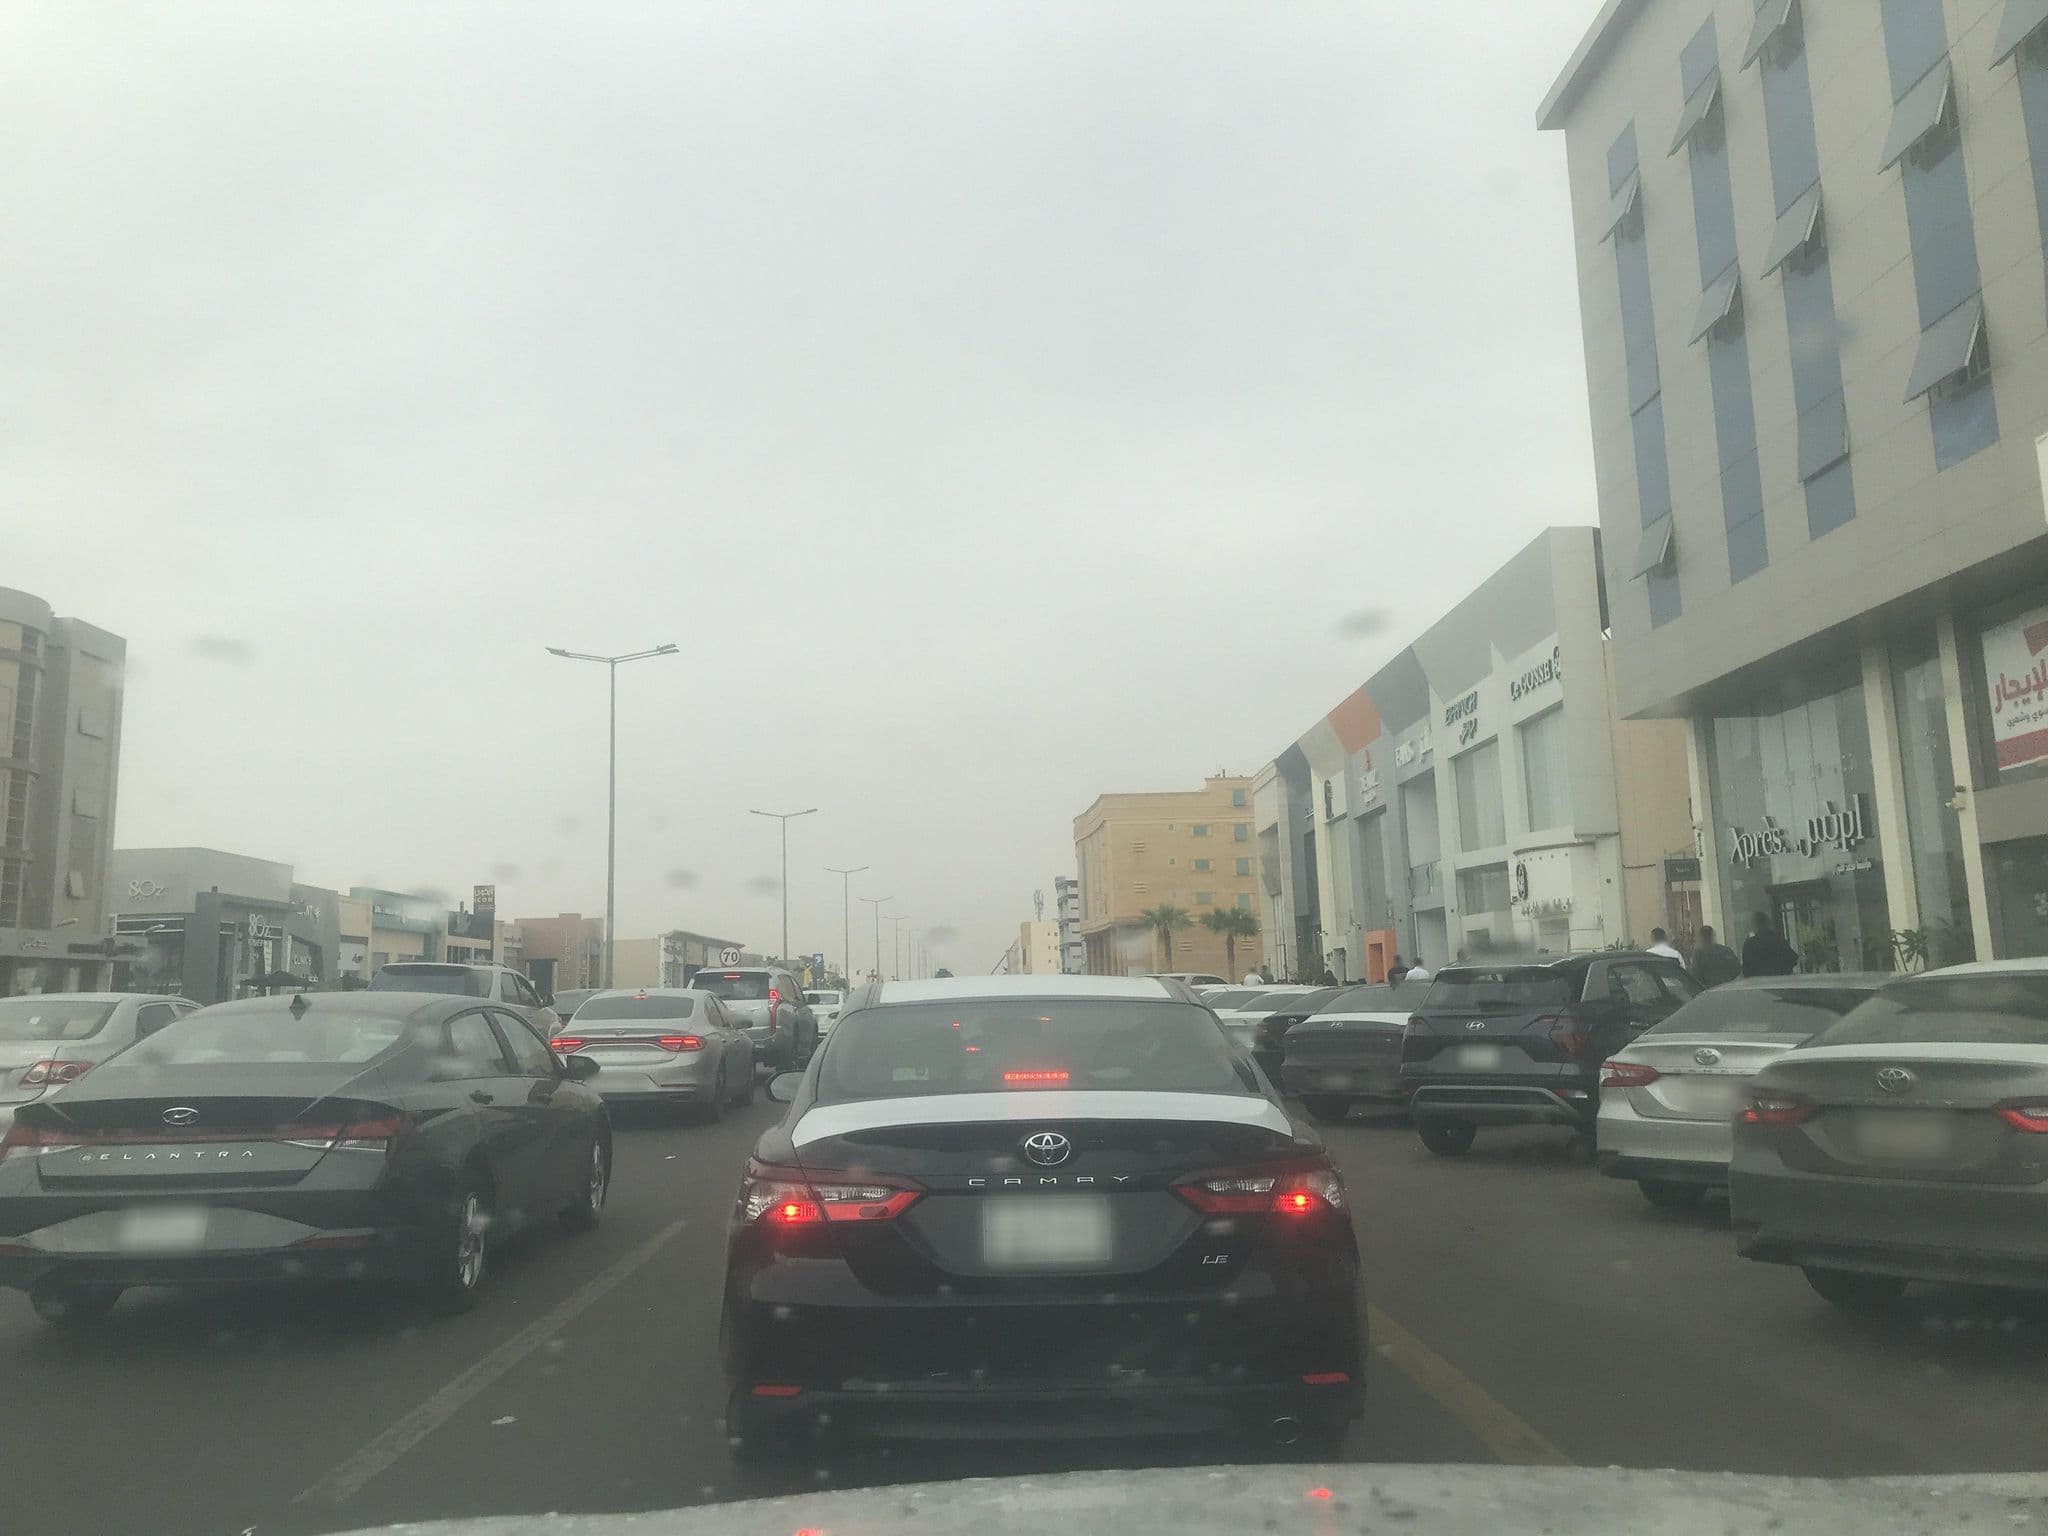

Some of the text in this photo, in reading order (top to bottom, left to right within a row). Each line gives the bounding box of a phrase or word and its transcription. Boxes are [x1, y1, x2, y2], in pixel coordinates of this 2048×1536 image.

[1995, 658, 2048, 714] لإيجار
[723, 951, 738, 962] 70
[99, 1150, 253, 1160] ELANTRA
[968, 1175, 1128, 1186] CAMRY
[1202, 1255, 1229, 1264] LE
